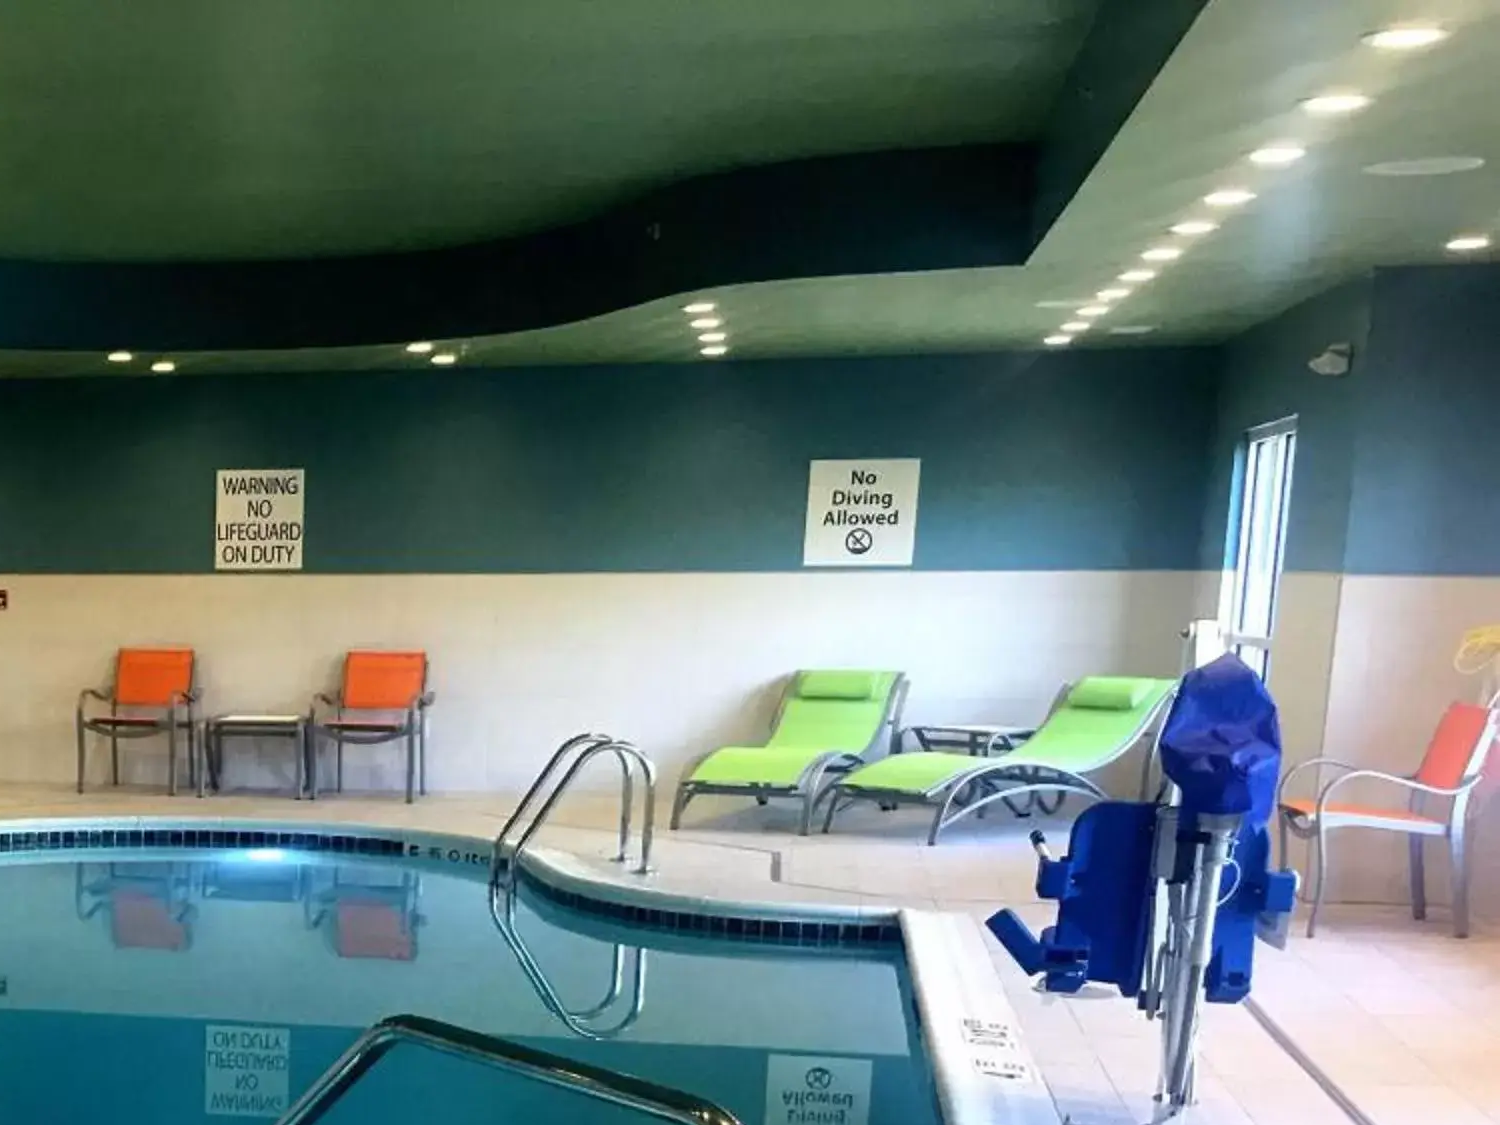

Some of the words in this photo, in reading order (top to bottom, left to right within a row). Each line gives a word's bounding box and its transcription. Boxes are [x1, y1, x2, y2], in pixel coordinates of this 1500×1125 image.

[222, 476, 299, 496] WARNING
[851, 469, 877, 485] No
[247, 499, 273, 518] NO
[832, 489, 893, 509] Diving
[823, 509, 899, 526] Allowed
[217, 521, 301, 541] LIFEGUARD
[222, 545, 247, 563] ON
[251, 545, 295, 563] DUTY
